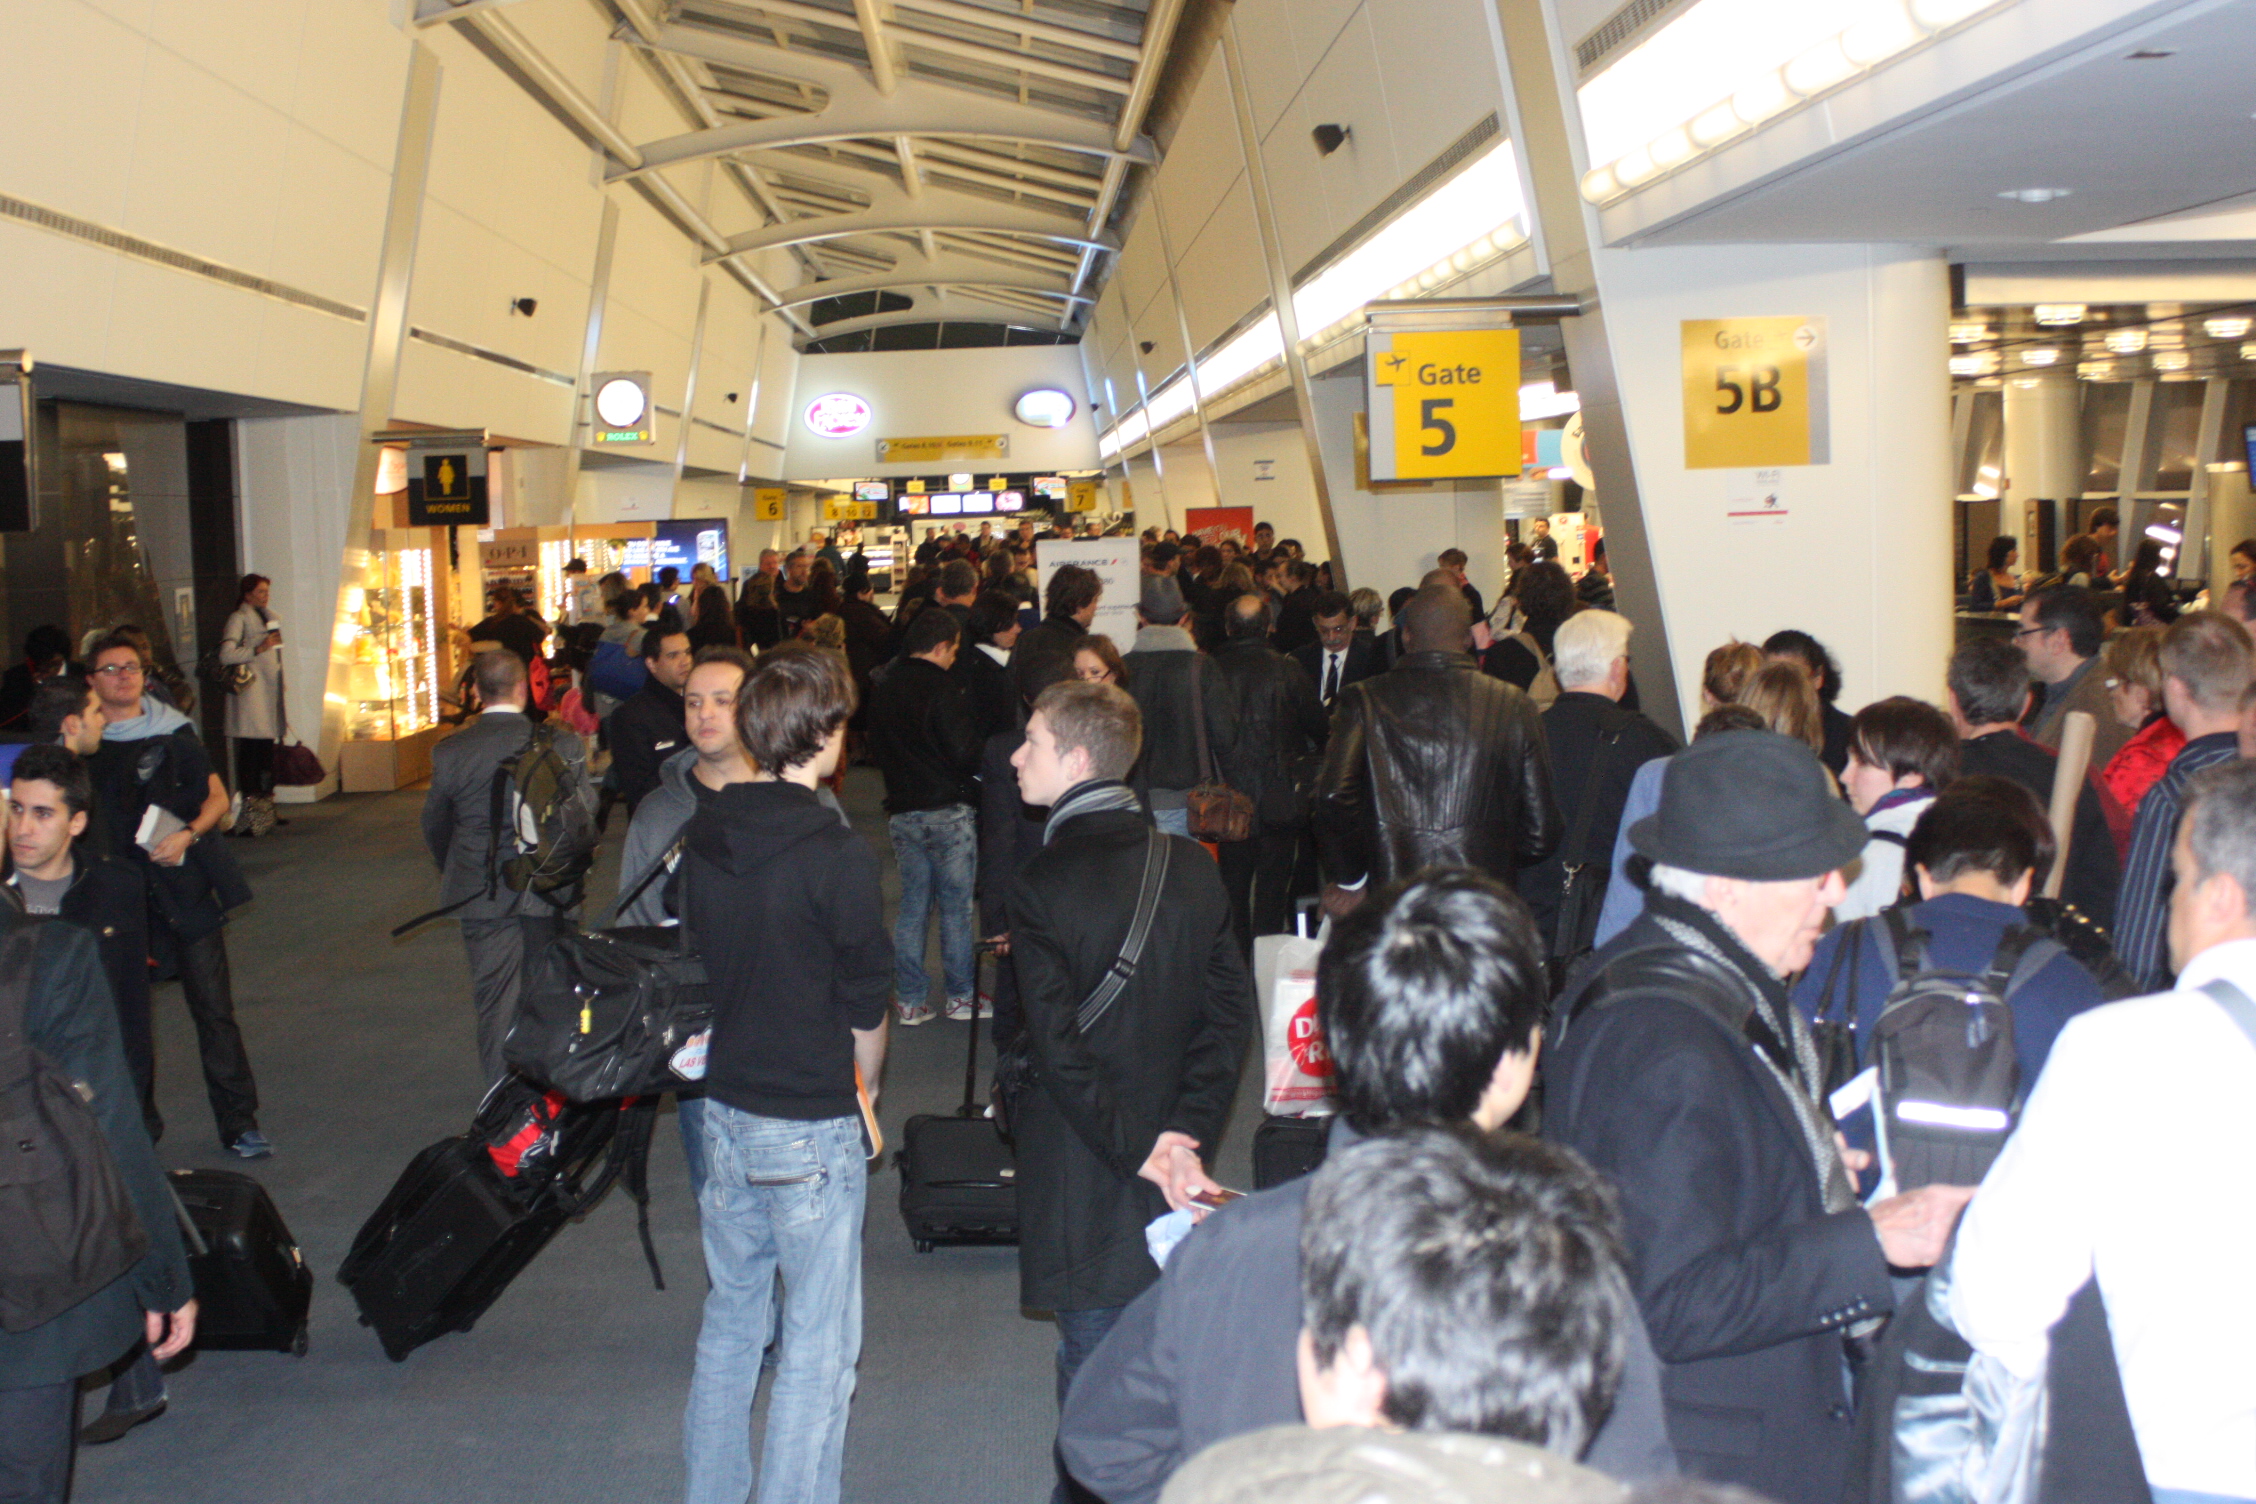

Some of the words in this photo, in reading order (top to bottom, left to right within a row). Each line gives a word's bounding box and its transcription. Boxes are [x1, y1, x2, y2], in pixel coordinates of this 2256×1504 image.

[1715, 330, 1763, 350] Gate
[1418, 363, 1481, 385] Gate
[1716, 364, 1782, 414] 5B
[1421, 398, 1456, 456] 5
[606, 432, 639, 441] ROLEX
[426, 503, 471, 513] WOMEN
[1077, 494, 1085, 506] 7
[768, 502, 778, 515] 6
